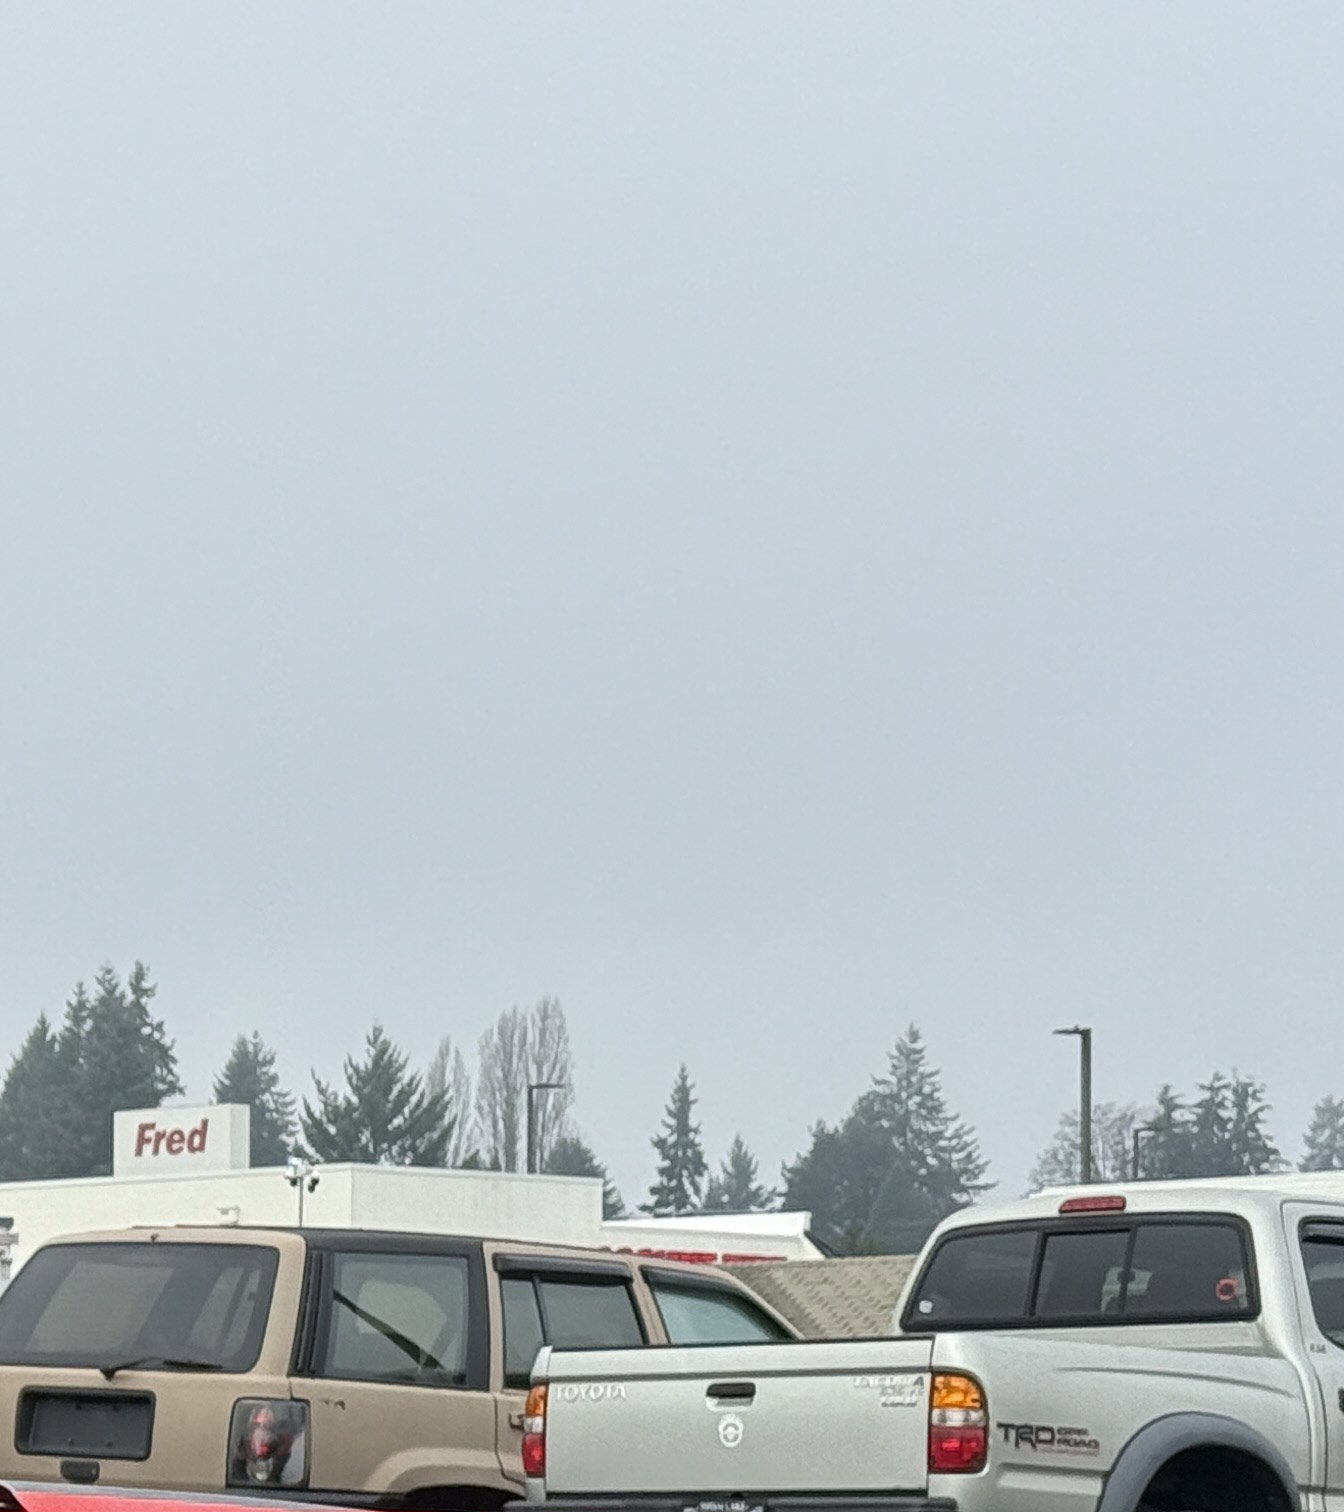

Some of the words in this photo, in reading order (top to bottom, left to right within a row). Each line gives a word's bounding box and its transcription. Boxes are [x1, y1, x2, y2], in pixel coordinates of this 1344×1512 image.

[134, 1117, 210, 1158] Fred
[553, 1383, 627, 1403] TOYOTA
[996, 1422, 1055, 1450] TRD
